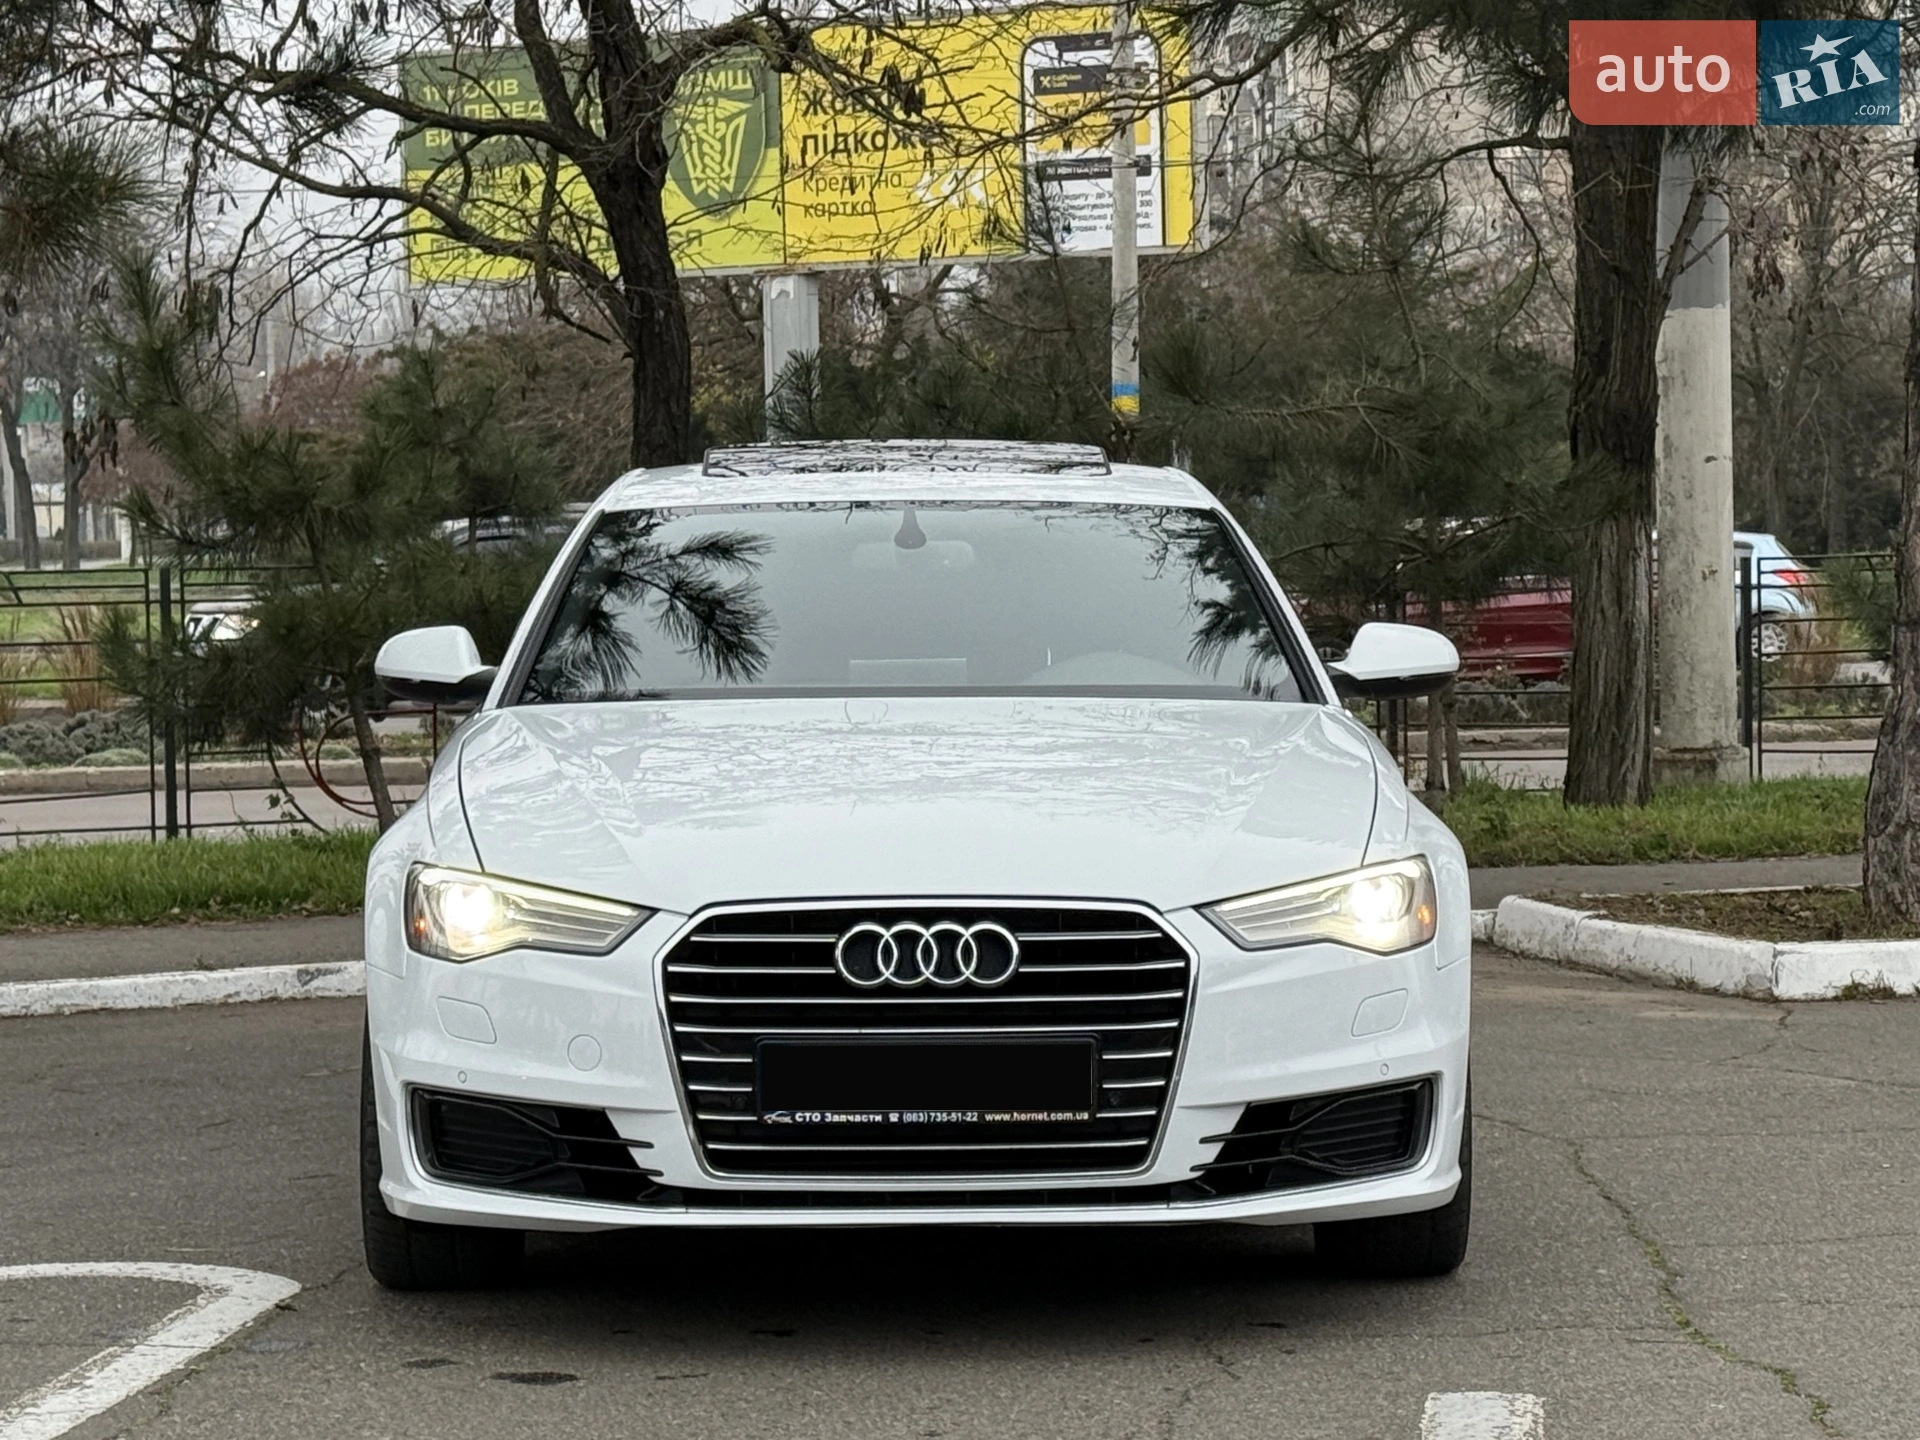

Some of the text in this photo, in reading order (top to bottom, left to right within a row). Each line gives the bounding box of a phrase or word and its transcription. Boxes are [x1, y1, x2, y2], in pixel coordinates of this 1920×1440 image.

[803, 200, 874, 222] картка
[795, 1112, 821, 1122] СТО
[825, 1112, 882, 1123] Запчасти
[984, 1111, 1089, 1122] www.hornet.com.ua
